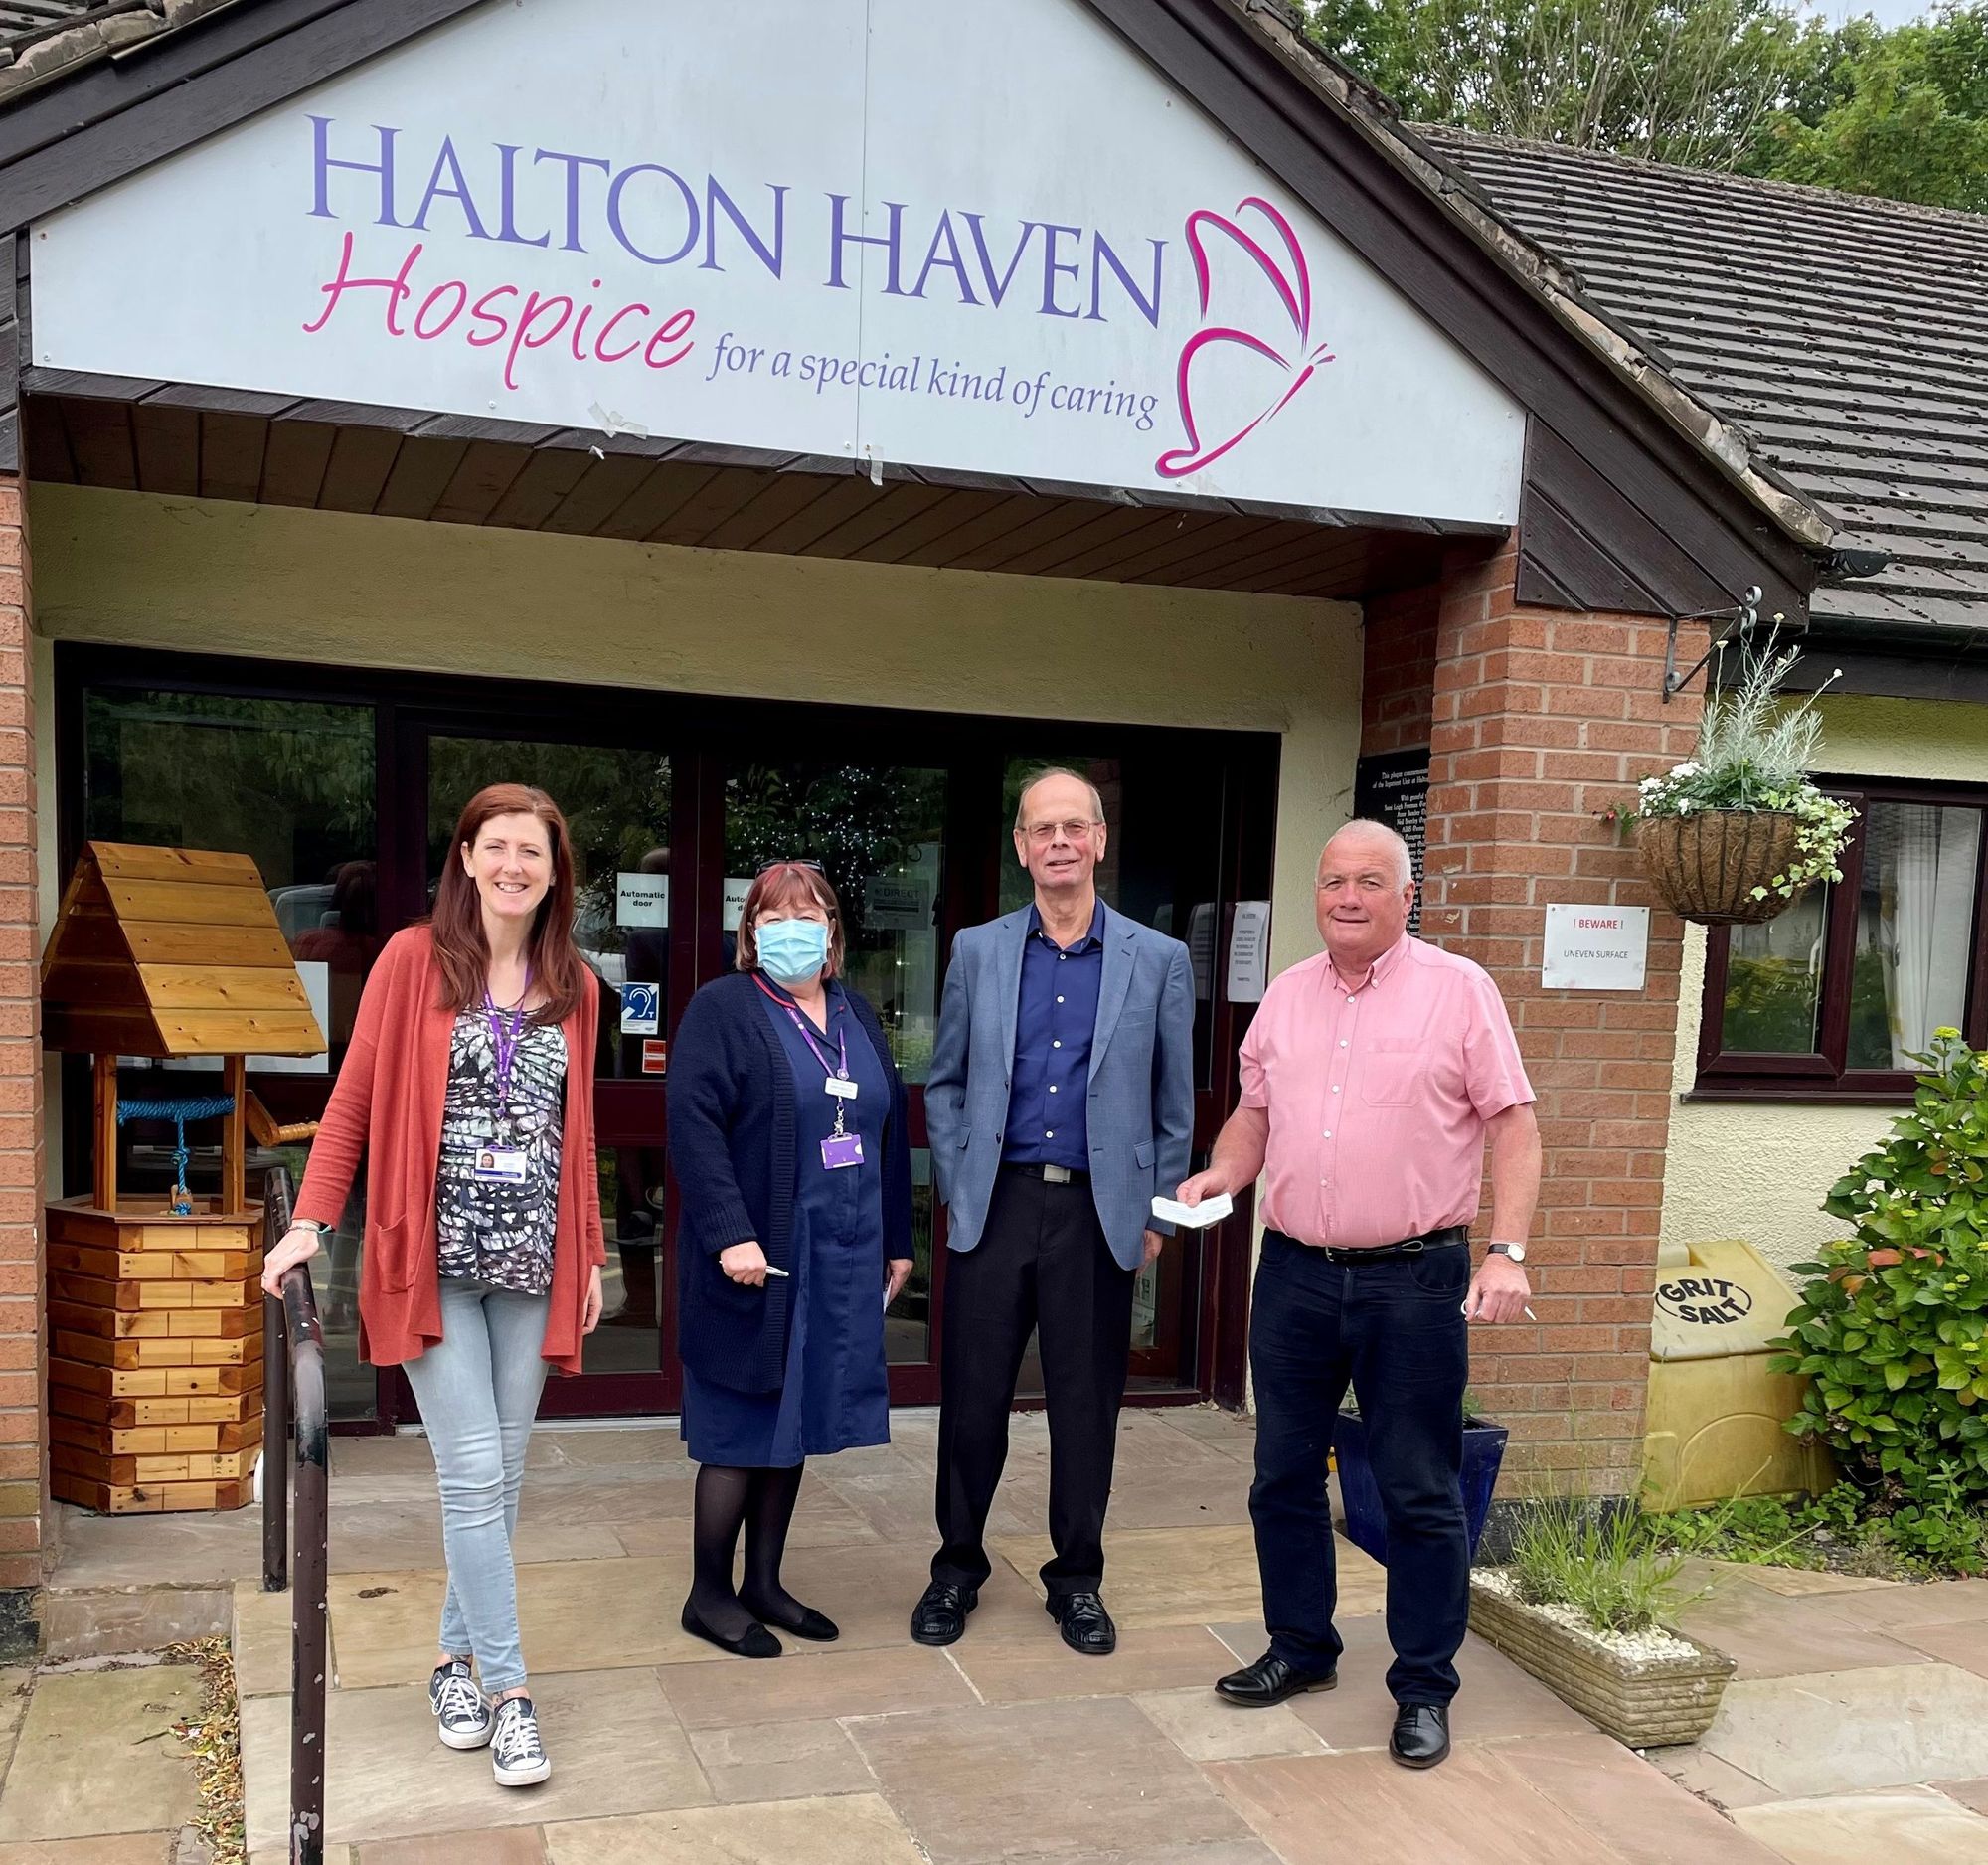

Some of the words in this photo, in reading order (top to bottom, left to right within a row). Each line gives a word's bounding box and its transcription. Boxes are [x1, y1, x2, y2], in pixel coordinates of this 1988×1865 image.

[303, 114, 792, 281] HALTON
[823, 192, 1170, 329] HAVEN
[302, 231, 695, 390] Hospice
[705, 332, 765, 381] for
[771, 351, 791, 377] a
[799, 352, 921, 394] special
[927, 358, 1007, 402] kind
[1012, 371, 1051, 418] of
[1051, 380, 1158, 431] caring
[620, 890, 665, 899] Automatic
[1578, 919, 1618, 929] BEWARE
[1596, 950, 1628, 959] SURFACE
[1659, 1278, 1734, 1302] GRIT
[1678, 1296, 1748, 1324] SALT
